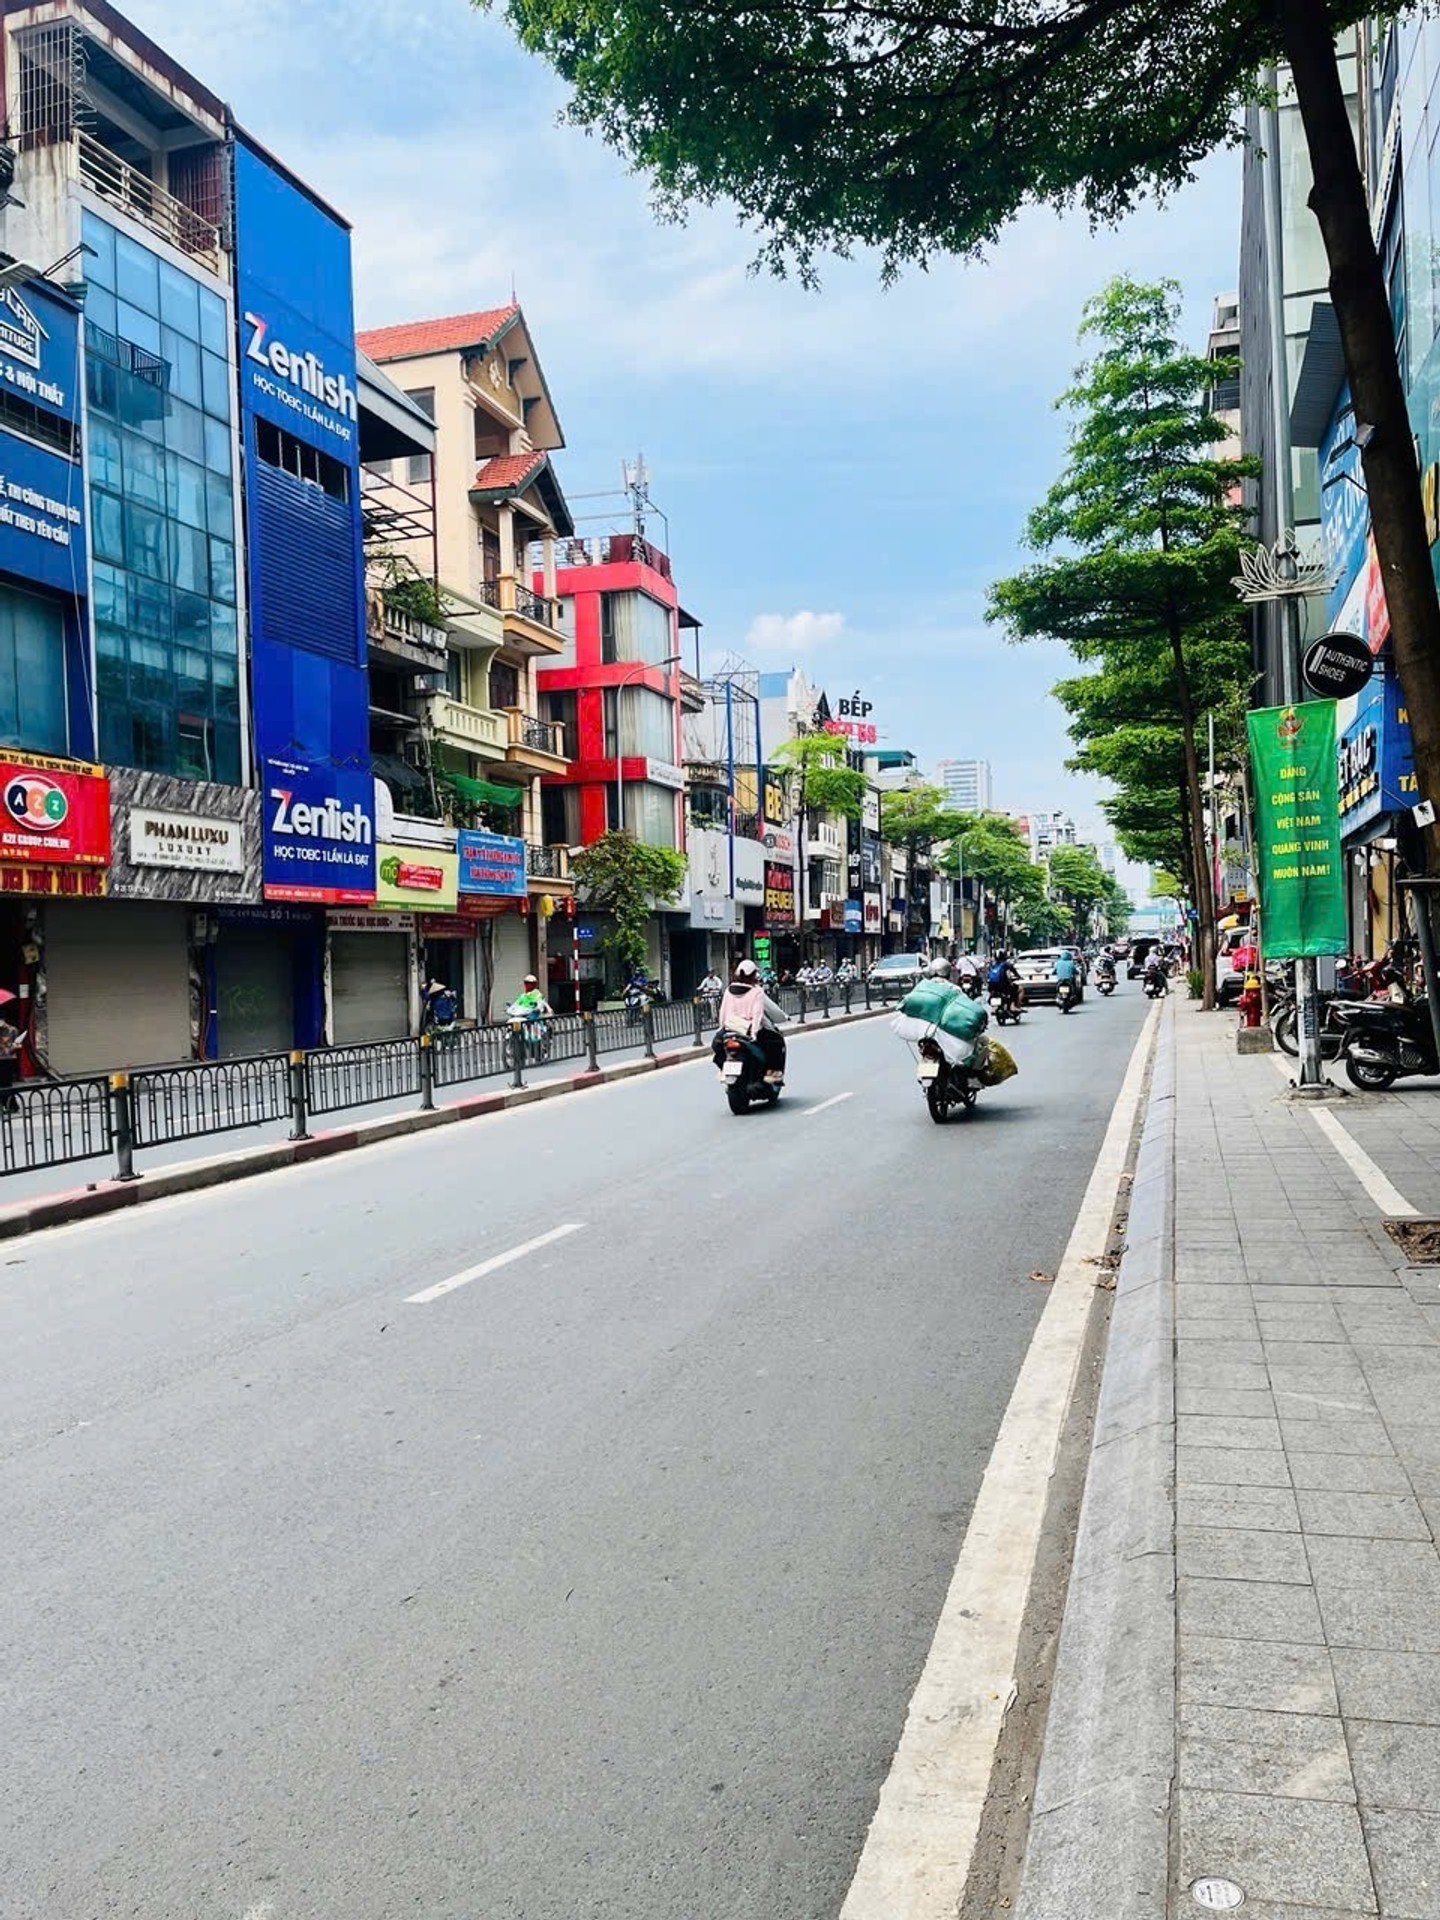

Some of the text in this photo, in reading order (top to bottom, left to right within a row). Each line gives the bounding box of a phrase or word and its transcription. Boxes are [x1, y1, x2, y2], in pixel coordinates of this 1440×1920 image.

[839, 690, 873, 718] BẾP
[1272, 792, 1296, 806] CỘNG
[1276, 815, 1322, 829] VIỆT NAM
[274, 845, 295, 861] HỌC
[296, 847, 321, 862] TOEIC
[1272, 840, 1329, 855] QUANG VINH
